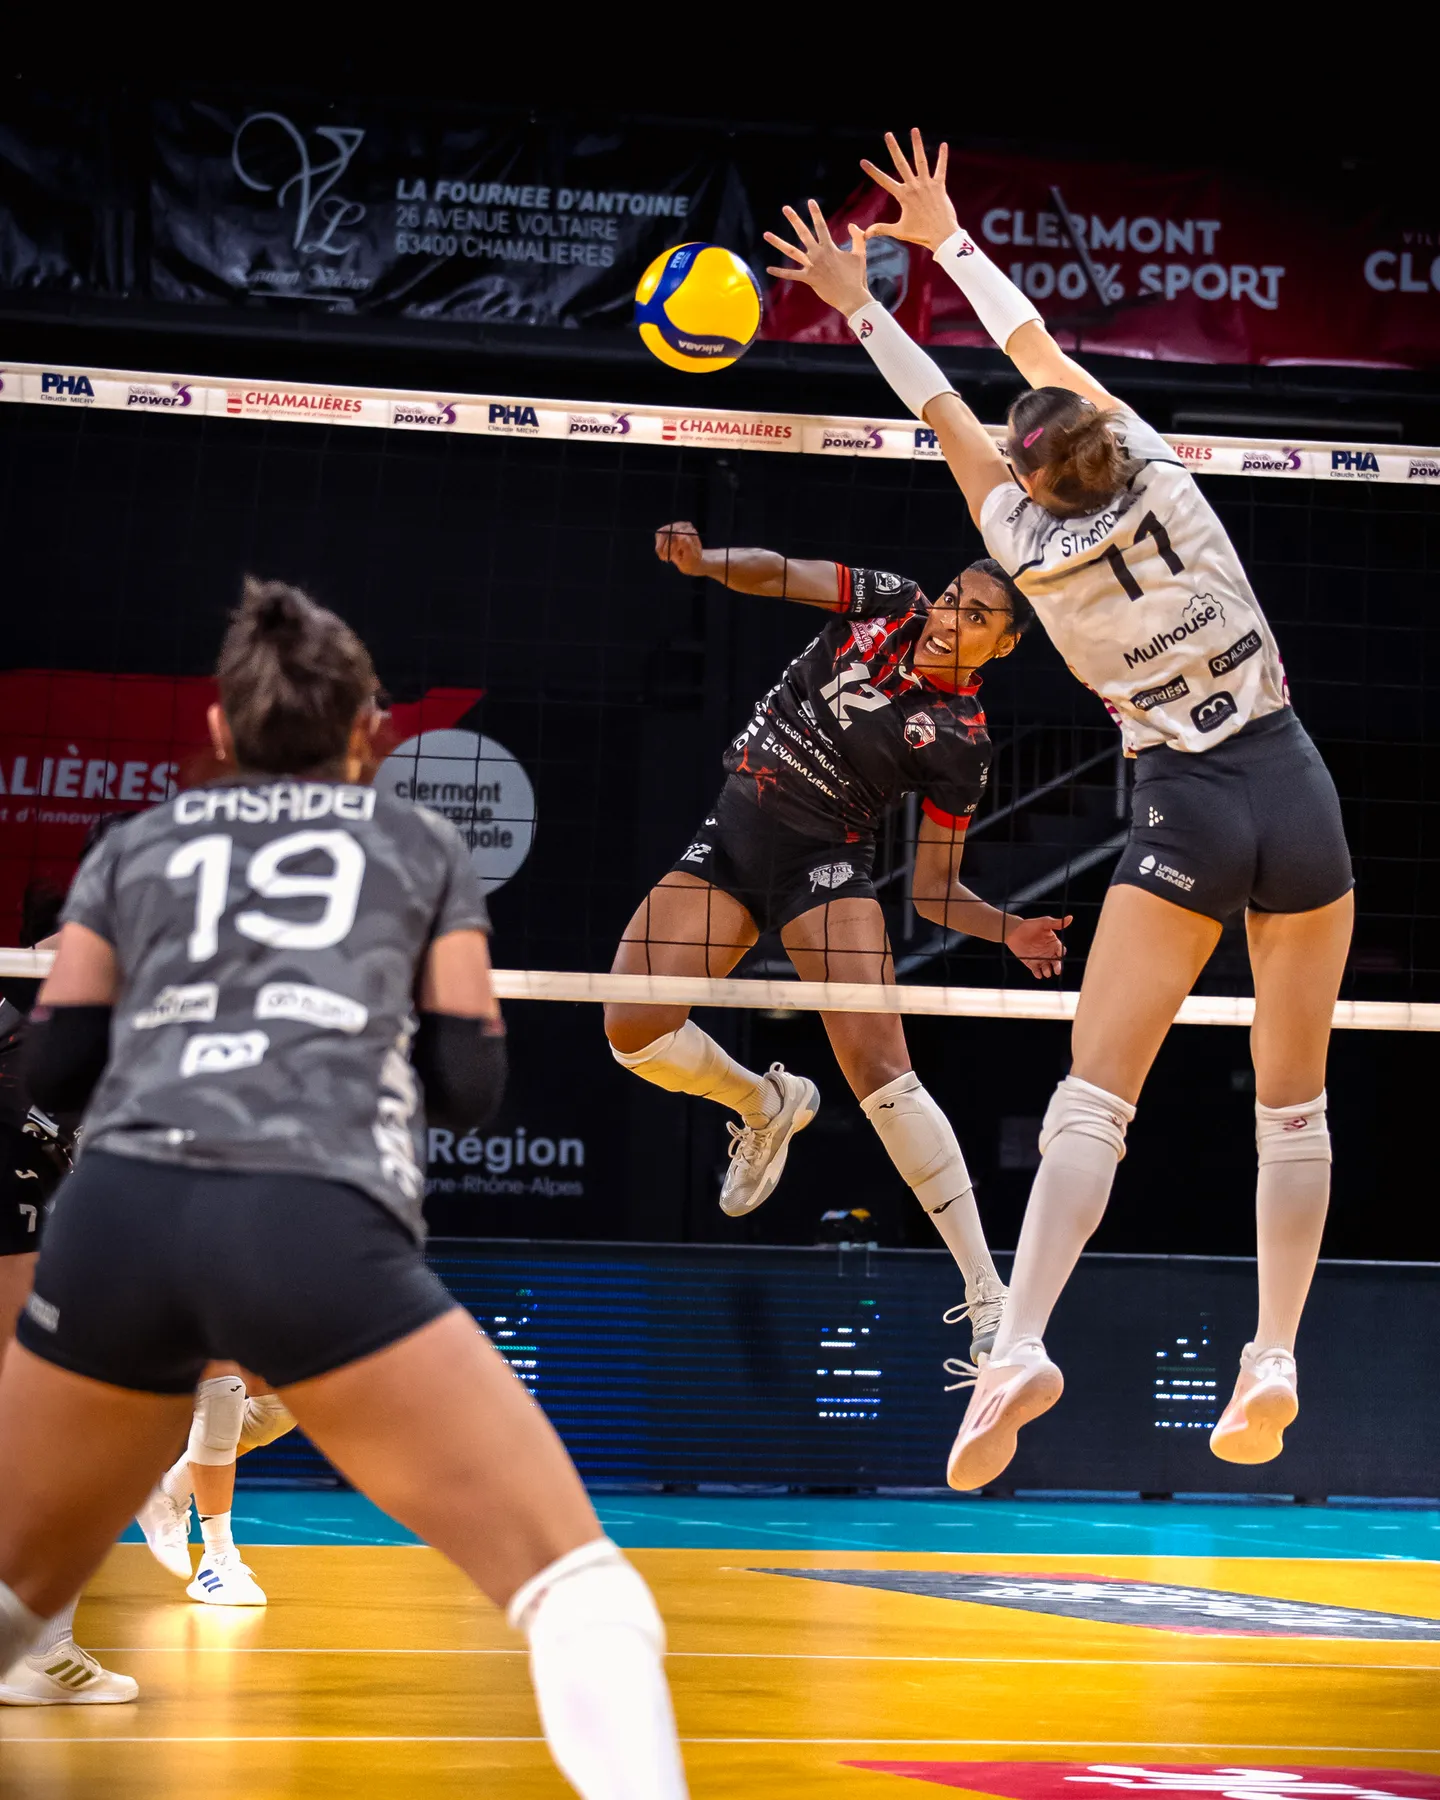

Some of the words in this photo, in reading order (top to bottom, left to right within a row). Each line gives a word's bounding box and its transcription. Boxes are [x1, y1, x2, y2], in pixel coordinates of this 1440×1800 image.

[395, 178, 427, 200] LA
[434, 180, 550, 209] FOURNEE
[556, 188, 690, 217] D'ANTOINE
[395, 206, 420, 228] 26
[424, 207, 510, 233] AVENUE
[516, 213, 618, 240] VOLTAIRE
[981, 208, 1221, 255] CLERMONT
[395, 233, 457, 256] 63400
[461, 235, 615, 268] CHAMALIERES
[1009, 261, 1125, 302] 100%
[1138, 264, 1285, 310] SPORT
[40, 394, 67, 402] Claude
[41, 372, 94, 397] PHA
[245, 391, 362, 413] CHAMALIÈRES
[488, 404, 539, 427] PHA
[488, 425, 514, 433] Claude
[516, 427, 539, 435] MICHY
[680, 419, 792, 438] CHAMALIÈRES
[1330, 471, 1355, 479] Claude
[1357, 472, 1380, 480] MICHY
[1331, 450, 1380, 473] PHA
[1099, 509, 1186, 602] 11
[1123, 603, 1217, 669] Mulhouse
[1230, 634, 1259, 662] ALSACE
[819, 662, 892, 731] 12
[394, 775, 502, 803] clermont
[174, 783, 377, 824] CASADEI
[812, 863, 852, 879] SPORT
[1154, 870, 1192, 892] DUMEZ
[1158, 862, 1195, 885] URBAN
[166, 828, 367, 963] 19
[427, 1126, 585, 1173] Région
[19, 1203, 38, 1233] 7
